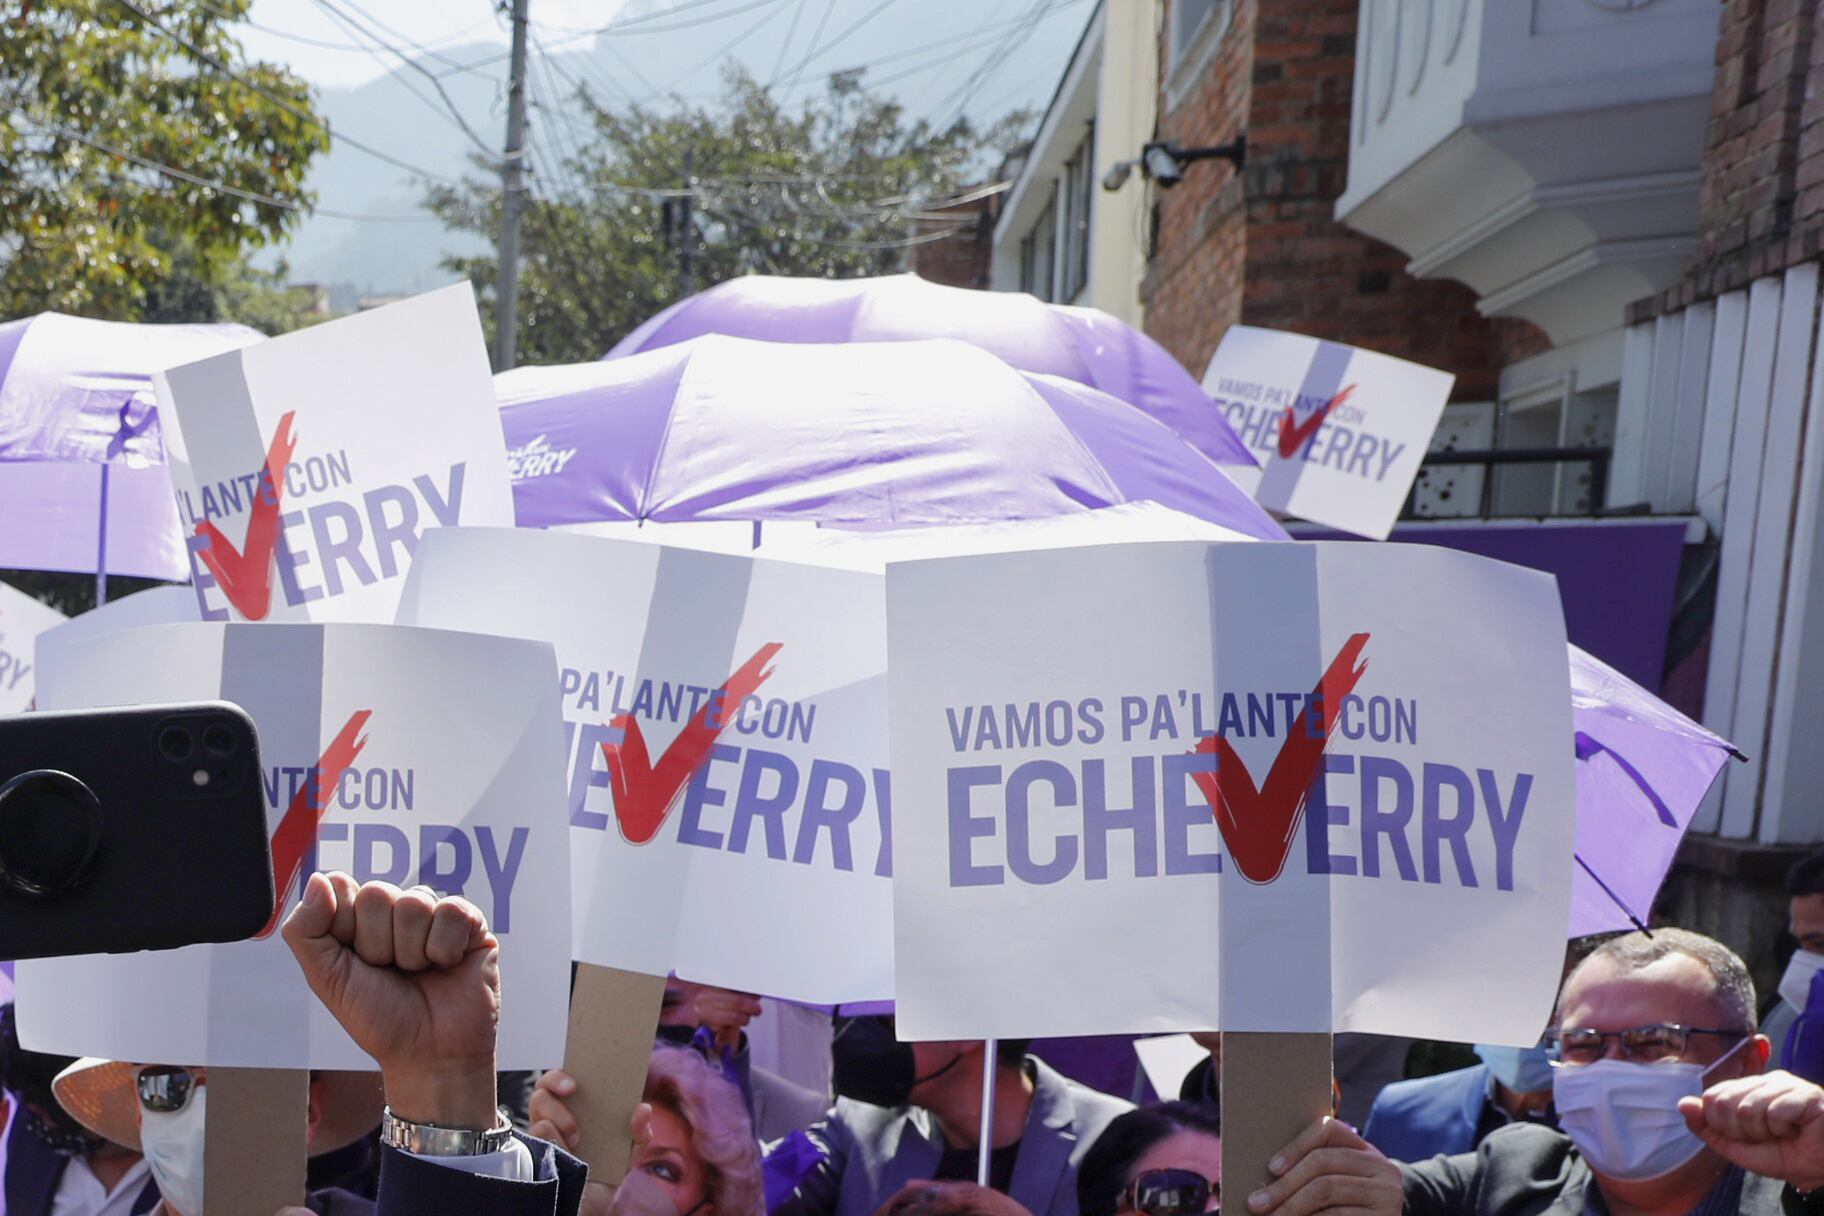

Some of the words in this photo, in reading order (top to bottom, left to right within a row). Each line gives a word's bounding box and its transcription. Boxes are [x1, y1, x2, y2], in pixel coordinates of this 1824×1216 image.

[282, 449, 353, 499] CON
[186, 461, 467, 622] EVERRY
[559, 667, 729, 729] PA'LANTE
[735, 694, 817, 744] CON
[945, 696, 1105, 752] VAMOS
[1120, 690, 1326, 742] PA'LANTE
[1339, 694, 1418, 745] CON
[338, 767, 414, 811] CON
[946, 752, 1535, 892] ECHEVERRY
